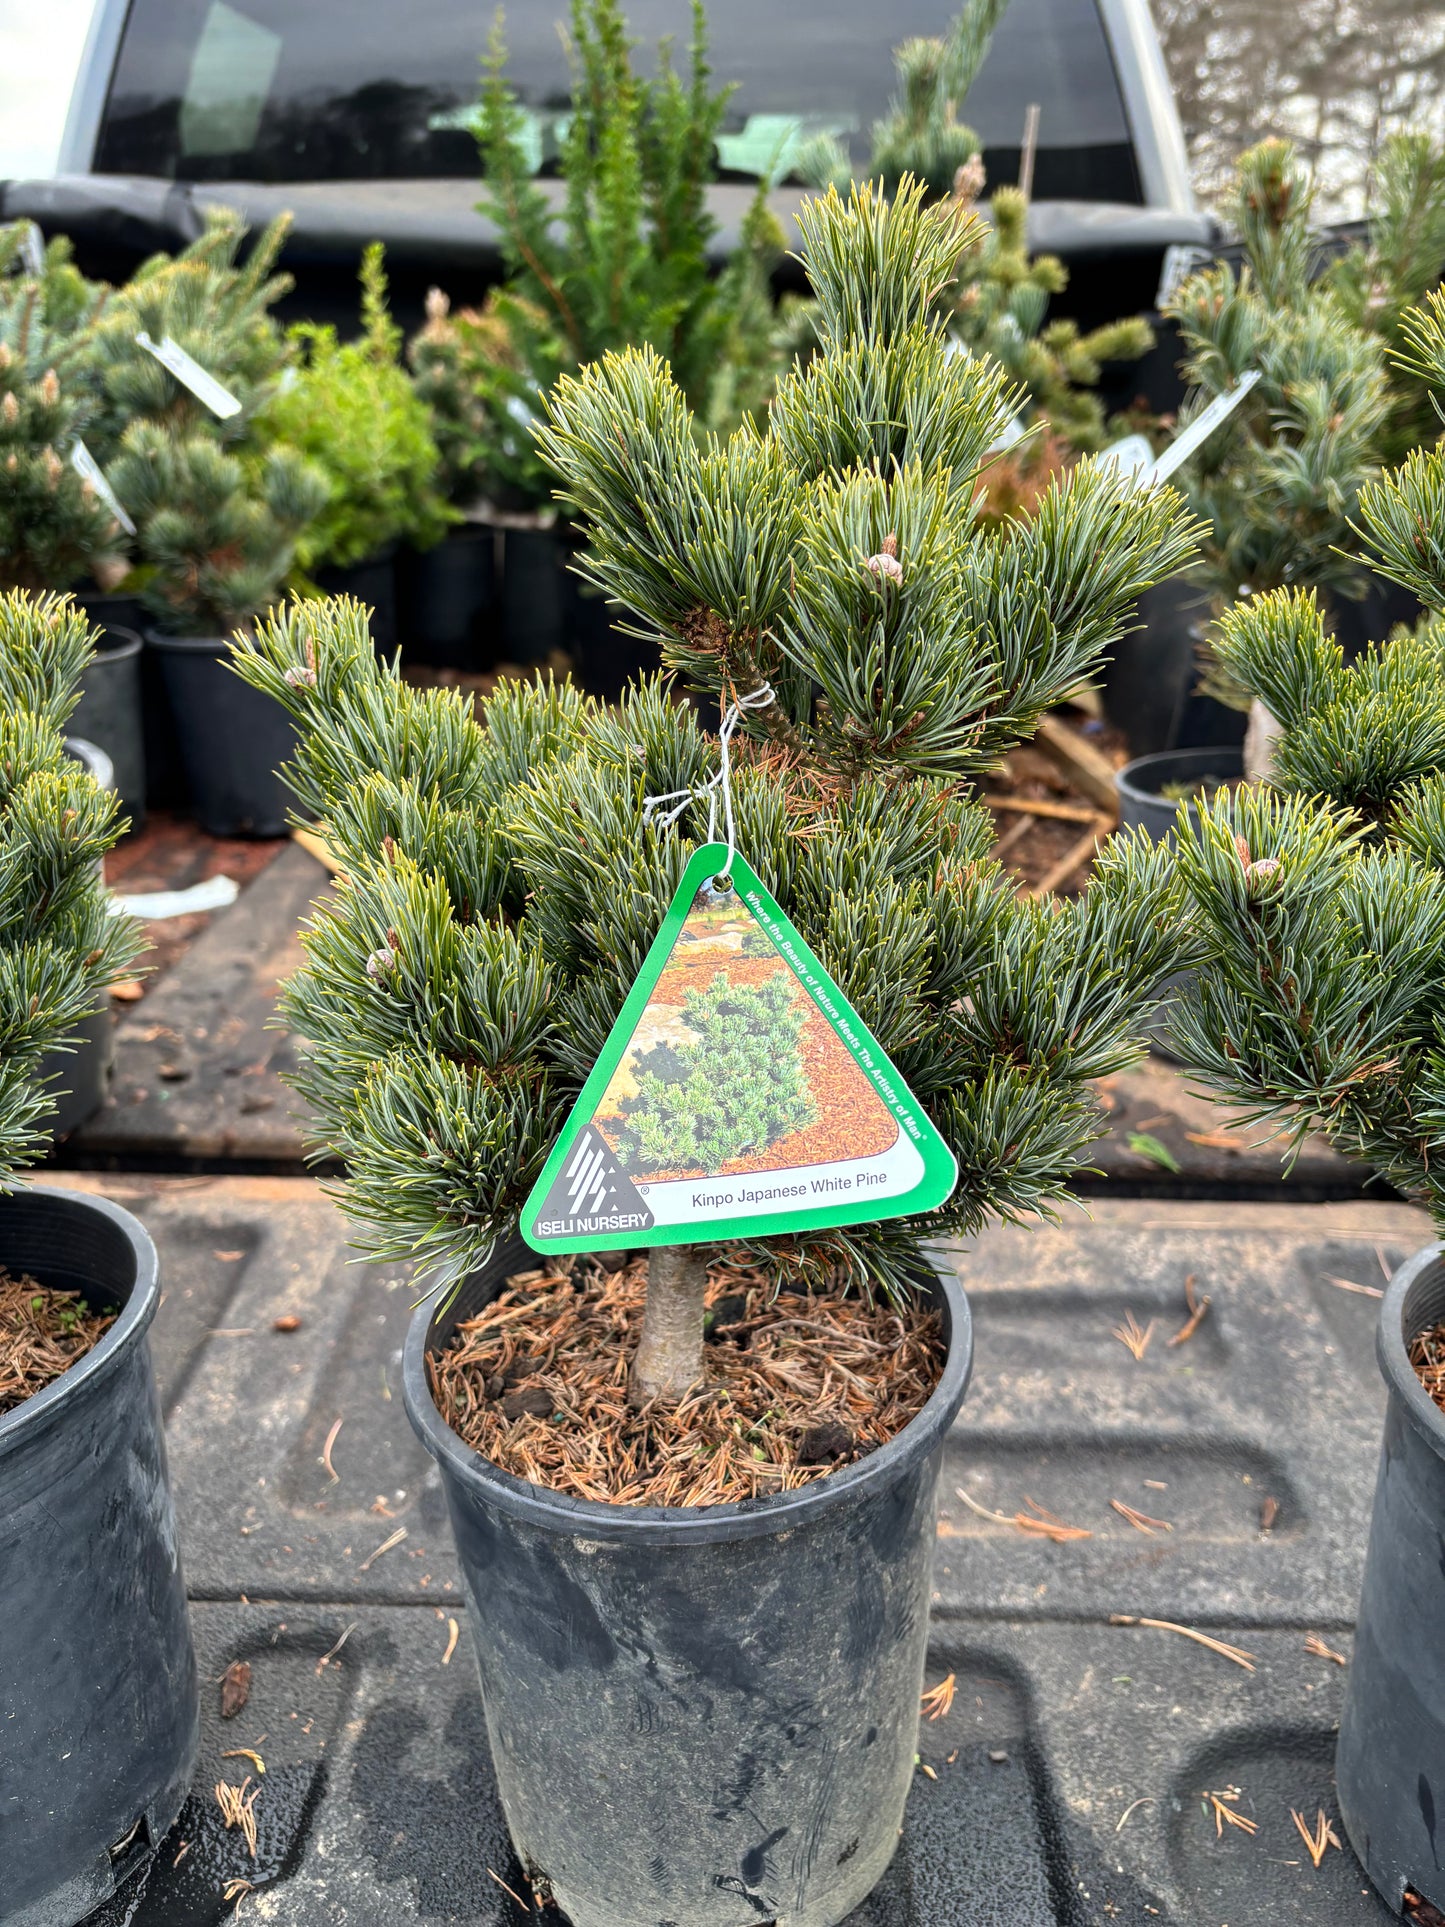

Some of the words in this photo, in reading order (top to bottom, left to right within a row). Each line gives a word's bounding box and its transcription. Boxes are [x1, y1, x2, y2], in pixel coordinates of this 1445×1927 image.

[746, 891, 770, 924] Where
[768, 924, 784, 942] the
[781, 941, 808, 975] Beauty
[805, 975, 818, 986] of
[814, 984, 839, 1018] Nature
[837, 1018, 860, 1048] Meets
[857, 1047, 874, 1069] The
[871, 1068, 899, 1104] Artistry
[895, 1104, 908, 1117] of
[691, 1193, 733, 1208] Kinpo
[737, 1183, 807, 1204] Japanese
[810, 1176, 852, 1194] White
[856, 1171, 888, 1187] Pine
[537, 1219, 574, 1236] ISELI
[576, 1212, 649, 1232] NURSERY
